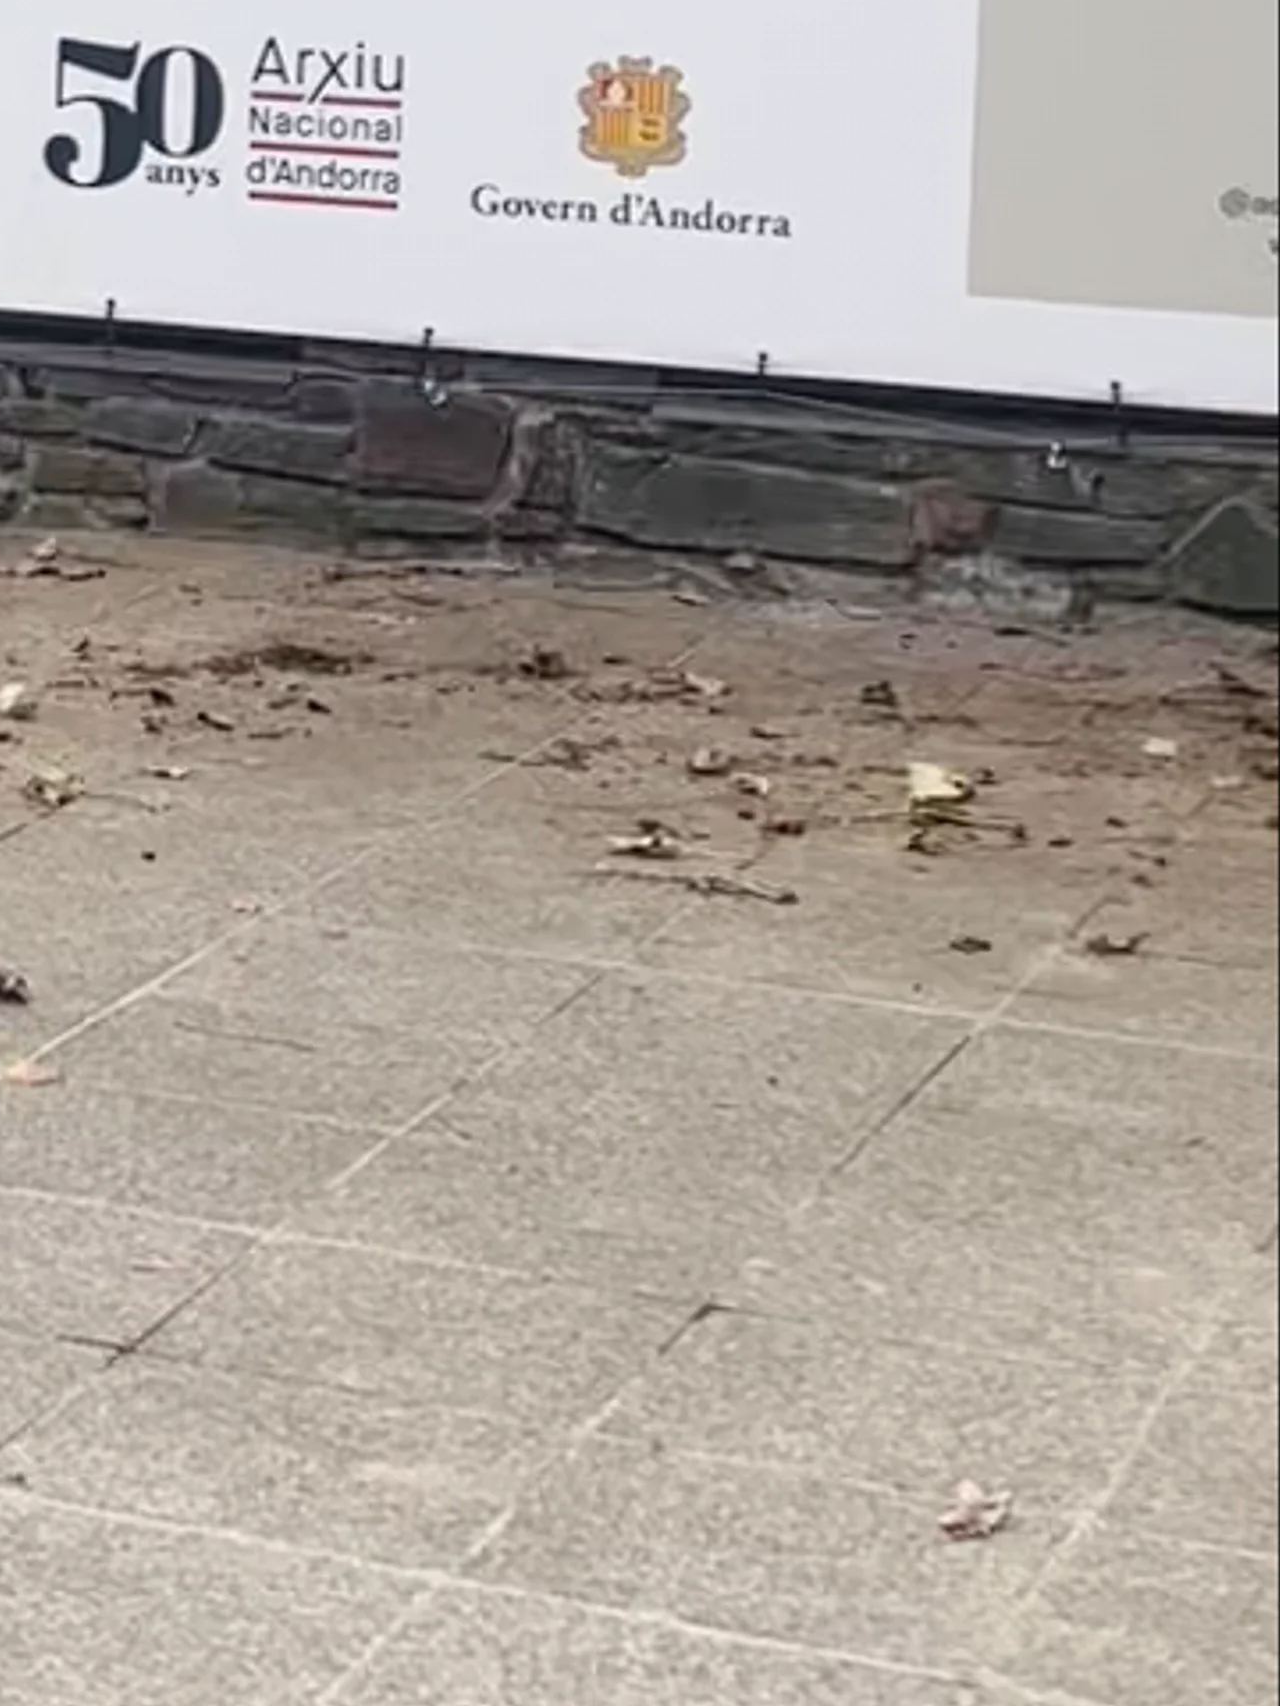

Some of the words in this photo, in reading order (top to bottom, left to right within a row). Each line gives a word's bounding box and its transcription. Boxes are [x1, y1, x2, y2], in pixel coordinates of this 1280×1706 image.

[251, 36, 404, 105] Arxiu
[44, 38, 224, 188] 50
[250, 106, 402, 143] Nacional
[146, 162, 222, 195] anys
[246, 157, 399, 195] d'Andorra
[470, 186, 596, 224] Govern
[609, 195, 792, 239] d'Andorra
